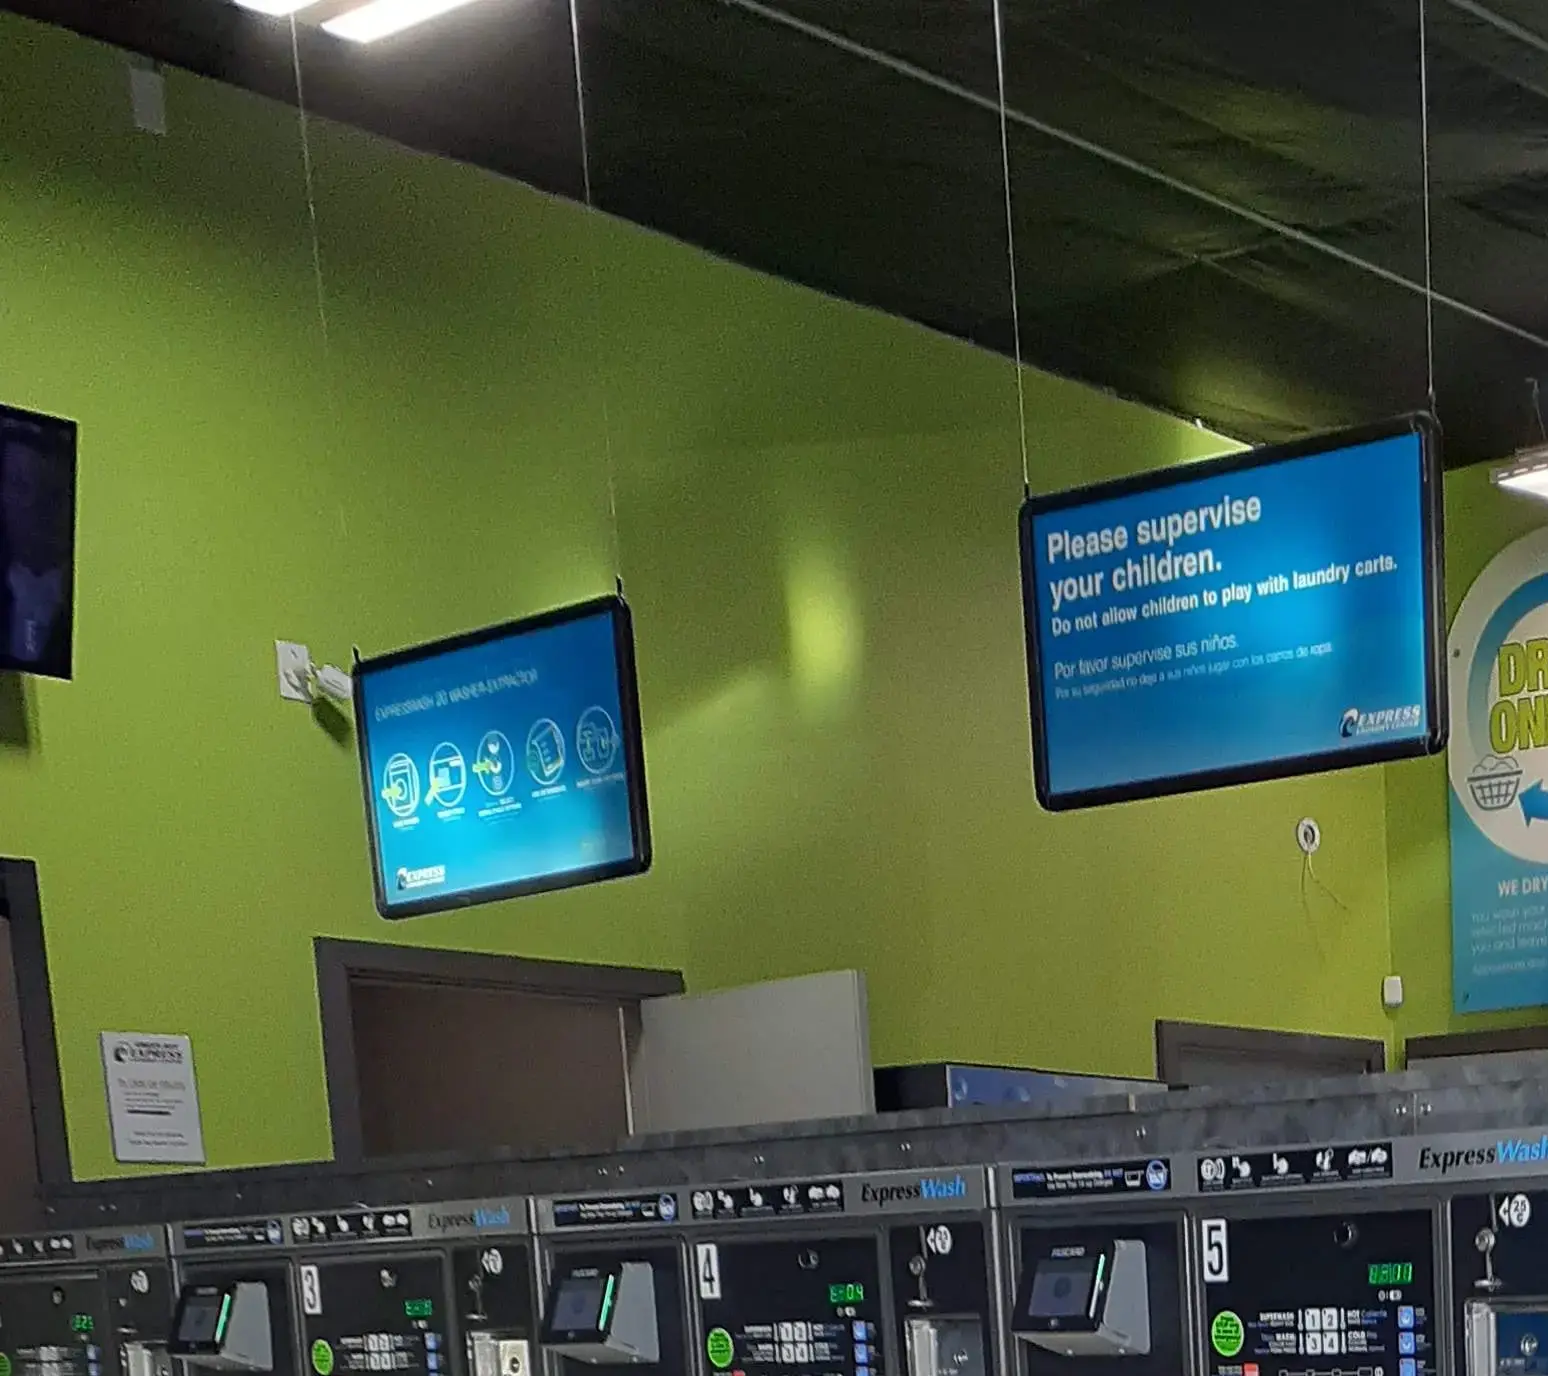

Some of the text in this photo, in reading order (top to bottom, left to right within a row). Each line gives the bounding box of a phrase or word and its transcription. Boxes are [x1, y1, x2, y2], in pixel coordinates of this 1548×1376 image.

[1047, 494, 1262, 564] Please supervise
[1049, 547, 1223, 612] your children.
[1052, 554, 1398, 637] Do not allow children to play with laundry carts.
[1054, 661, 1077, 680] Por
[1079, 656, 1109, 676] favor
[1111, 645, 1173, 671] supervise
[1175, 640, 1199, 659] sus
[1358, 704, 1421, 727] EXPRESS
[1498, 879, 1518, 897] WE
[1513, 1199, 1528, 1212] 25
[702, 1247, 716, 1294] 4
[1206, 1224, 1223, 1276] 5
[304, 1269, 316, 1310] 3
[1327, 1314, 1334, 1326] 2
